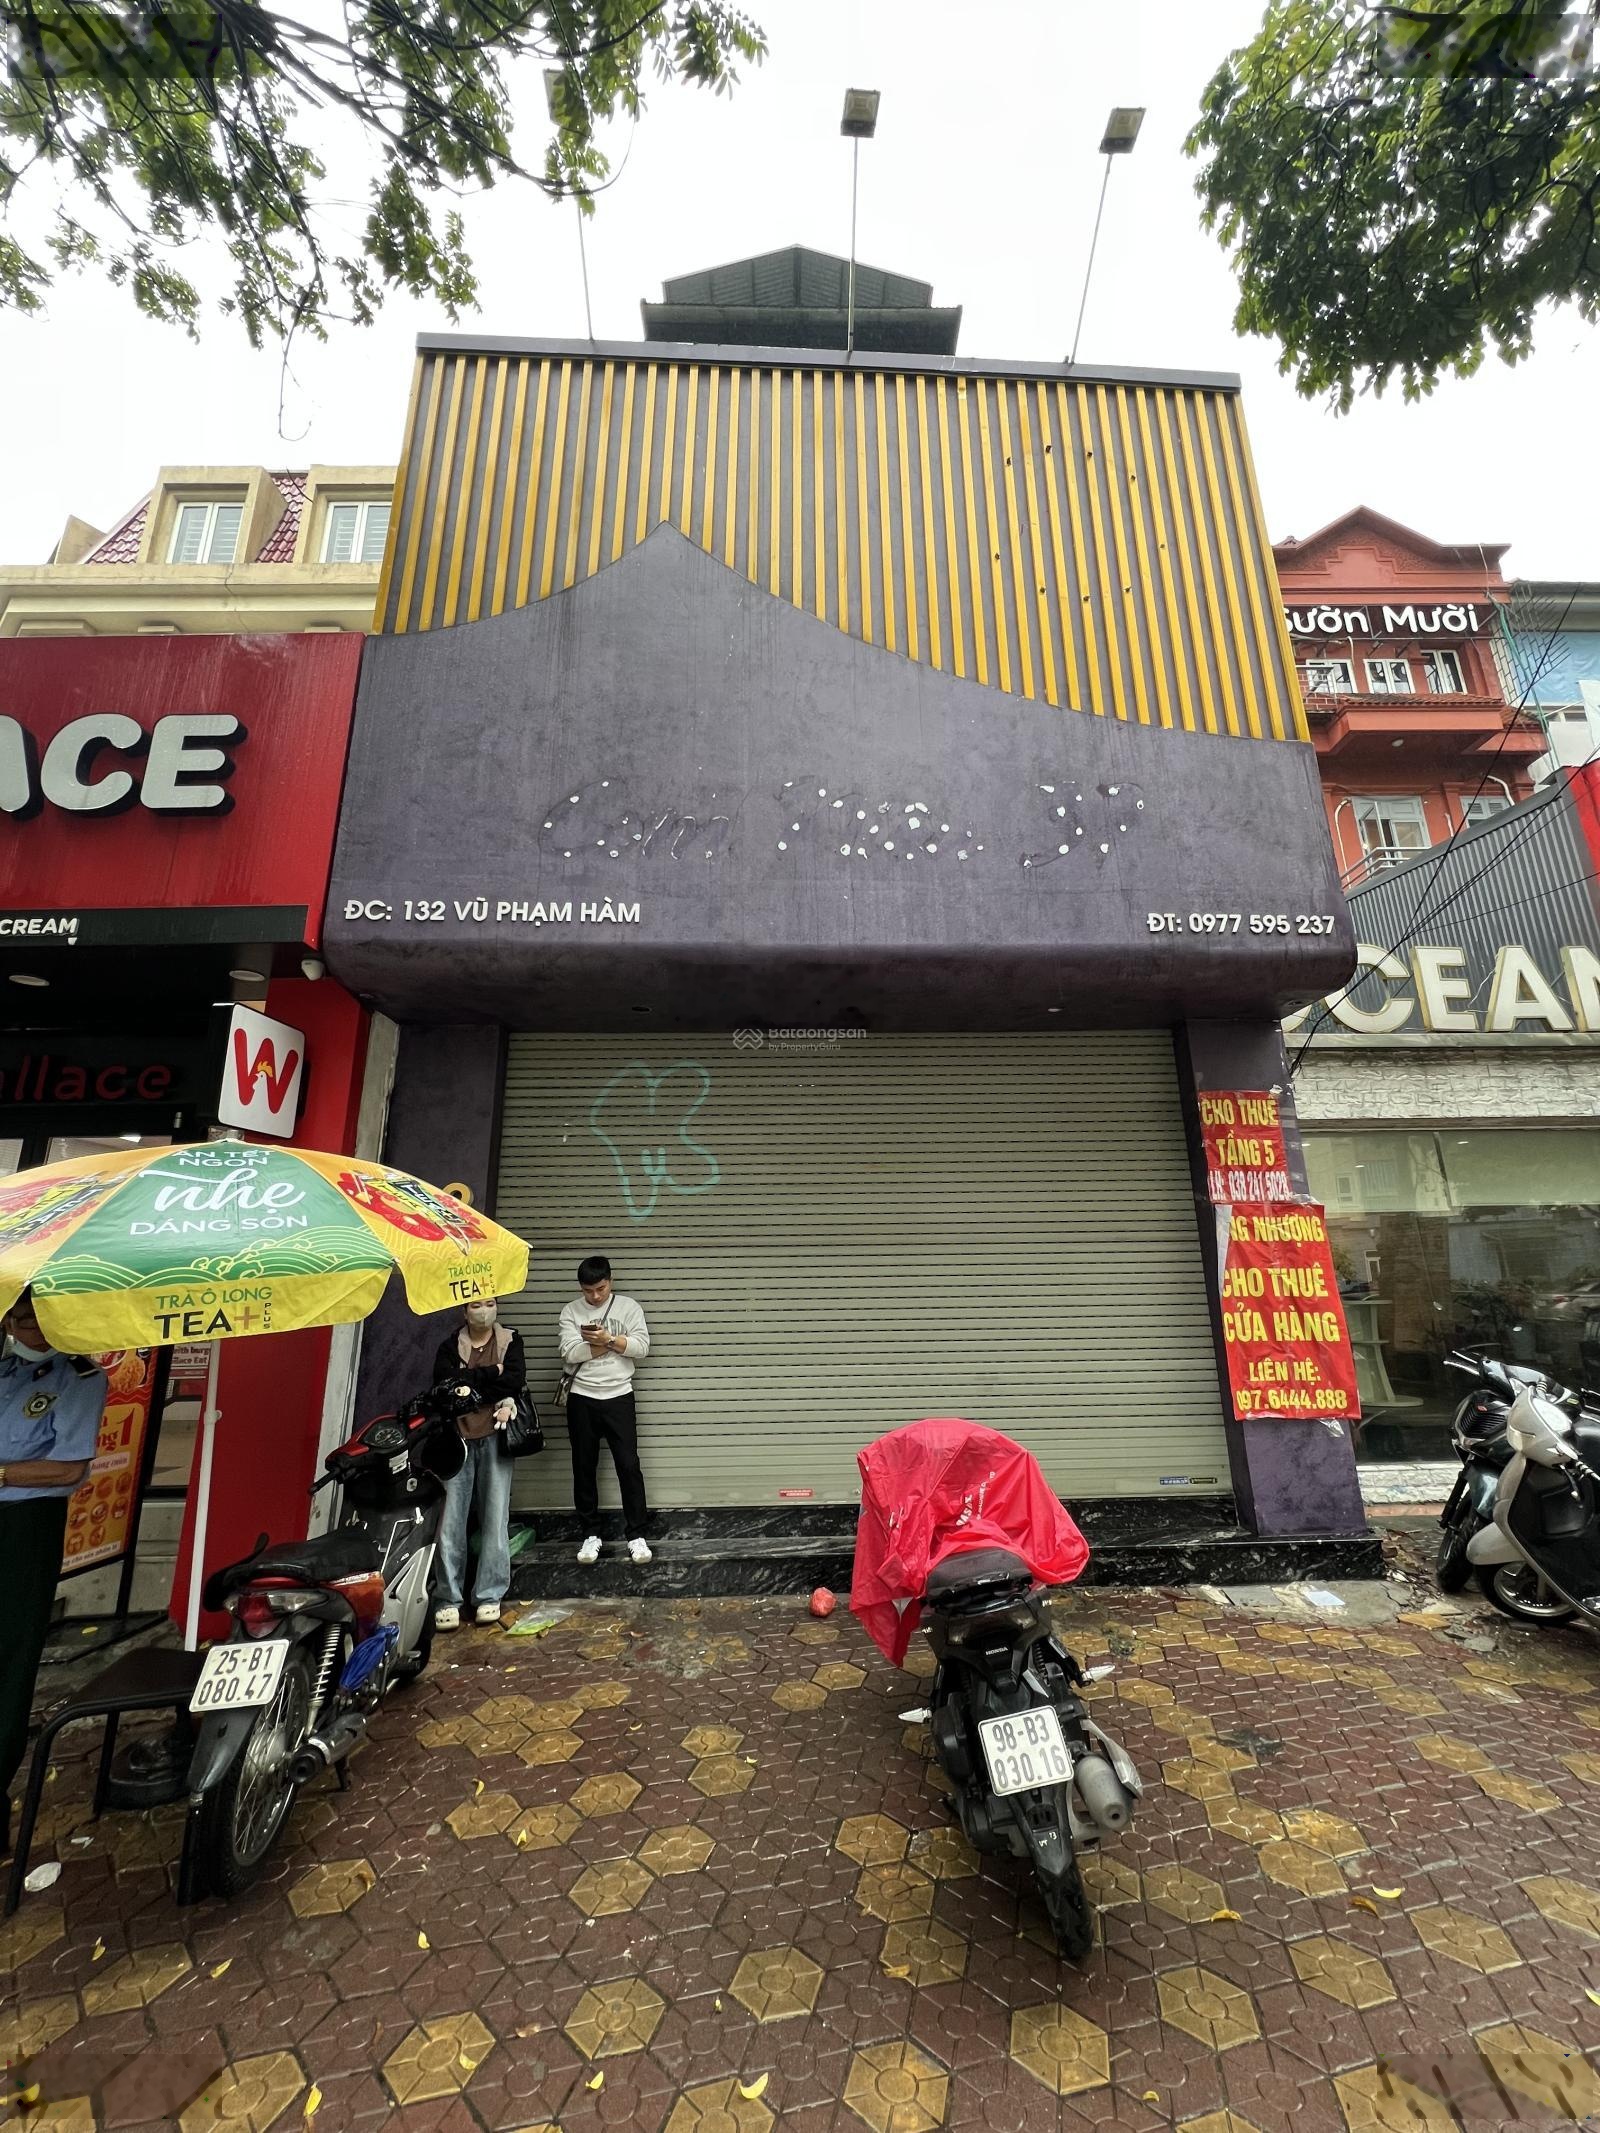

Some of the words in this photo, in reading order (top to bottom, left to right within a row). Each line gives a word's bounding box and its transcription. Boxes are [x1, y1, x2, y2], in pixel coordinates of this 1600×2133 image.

[1382, 603, 1479, 633] Mười
[0, 917, 78, 936] CREAM
[344, 900, 393, 921] ĐC:
[404, 900, 446, 922] 132
[454, 897, 489, 922] VŨ
[496, 902, 573, 927] PHẠM
[580, 896, 641, 923] HÀM
[1147, 912, 1183, 933] ĐT:
[1188, 912, 1242, 933] 0977
[1249, 914, 1291, 934] 595
[1295, 915, 1335, 934] 237
[1281, 943, 1600, 1034] CEA
[0, 1055, 172, 1100] llace
[1202, 1098, 1236, 1125] CHO
[1237, 1093, 1279, 1126] THUÊ
[179, 1157, 268, 1167] NGON
[1216, 1130, 1262, 1166] TẦNG
[1263, 1139, 1276, 1167] 5
[138, 1167, 307, 1214] nhẹ
[130, 1217, 232, 1236] DÁNG
[200, 1287, 217, 1305] Ô
[222, 1286, 273, 1304] LONG
[1222, 1267, 1264, 1298] CHO
[1268, 1262, 1329, 1298] THUÊ
[1223, 1302, 1268, 1343] CỬA
[1273, 1305, 1341, 1343] HÀNG
[1248, 1357, 1288, 1382] LIÊN
[1293, 1357, 1321, 1386] HỆ:
[213, 1645, 274, 1676] 25-B1
[197, 1673, 273, 1706] 080.47
[991, 1713, 1050, 1753] 98-B3
[993, 1744, 1067, 1789] 830.16
